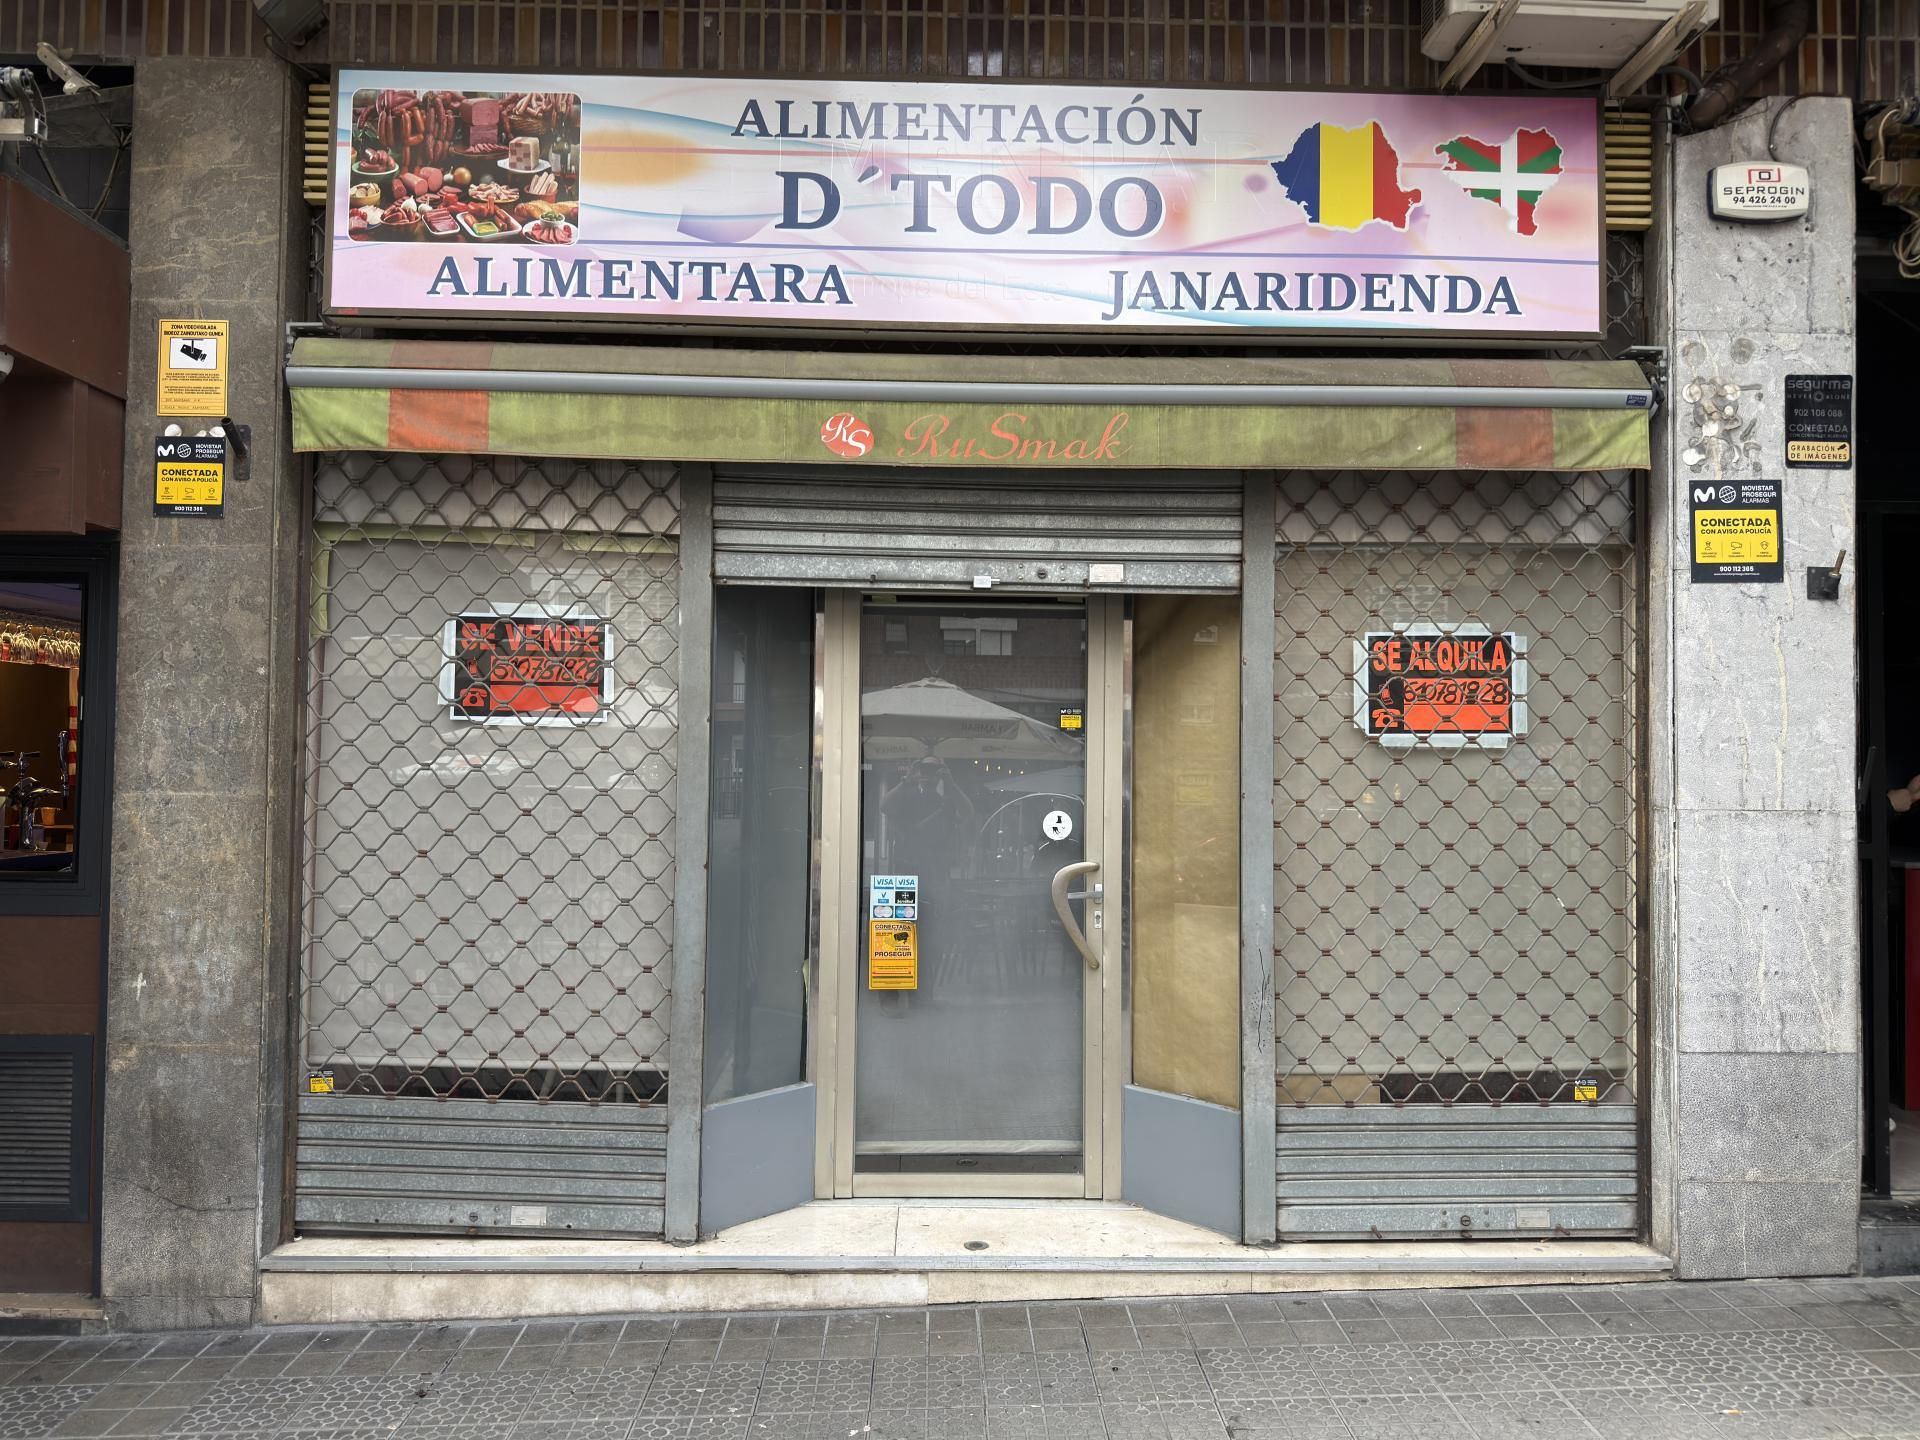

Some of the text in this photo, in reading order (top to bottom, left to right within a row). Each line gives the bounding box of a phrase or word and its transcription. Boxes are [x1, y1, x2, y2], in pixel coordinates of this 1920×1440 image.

[731, 94, 1203, 149] ALIMENTACIÓN
[1723, 185, 1806, 196] SEPROGIN
[1733, 196, 1796, 205] 94 426 24 00
[427, 256, 854, 305] ALIMENTARA
[1102, 271, 1522, 321] JANARIDENDA
[1787, 379, 1852, 392] segurma
[1794, 409, 1809, 417] 902
[1789, 423, 1849, 433] CONECTADA
[897, 411, 1134, 462] RuSmak
[1790, 443, 1835, 452] GRABACIÓN
[1804, 451, 1848, 461] IMÁGENES
[161, 469, 218, 477] CONECTADA
[1700, 518, 1771, 527] CONECTADA
[461, 622, 600, 652] SE VENDE
[1372, 640, 1507, 673] SE ALQUILA
